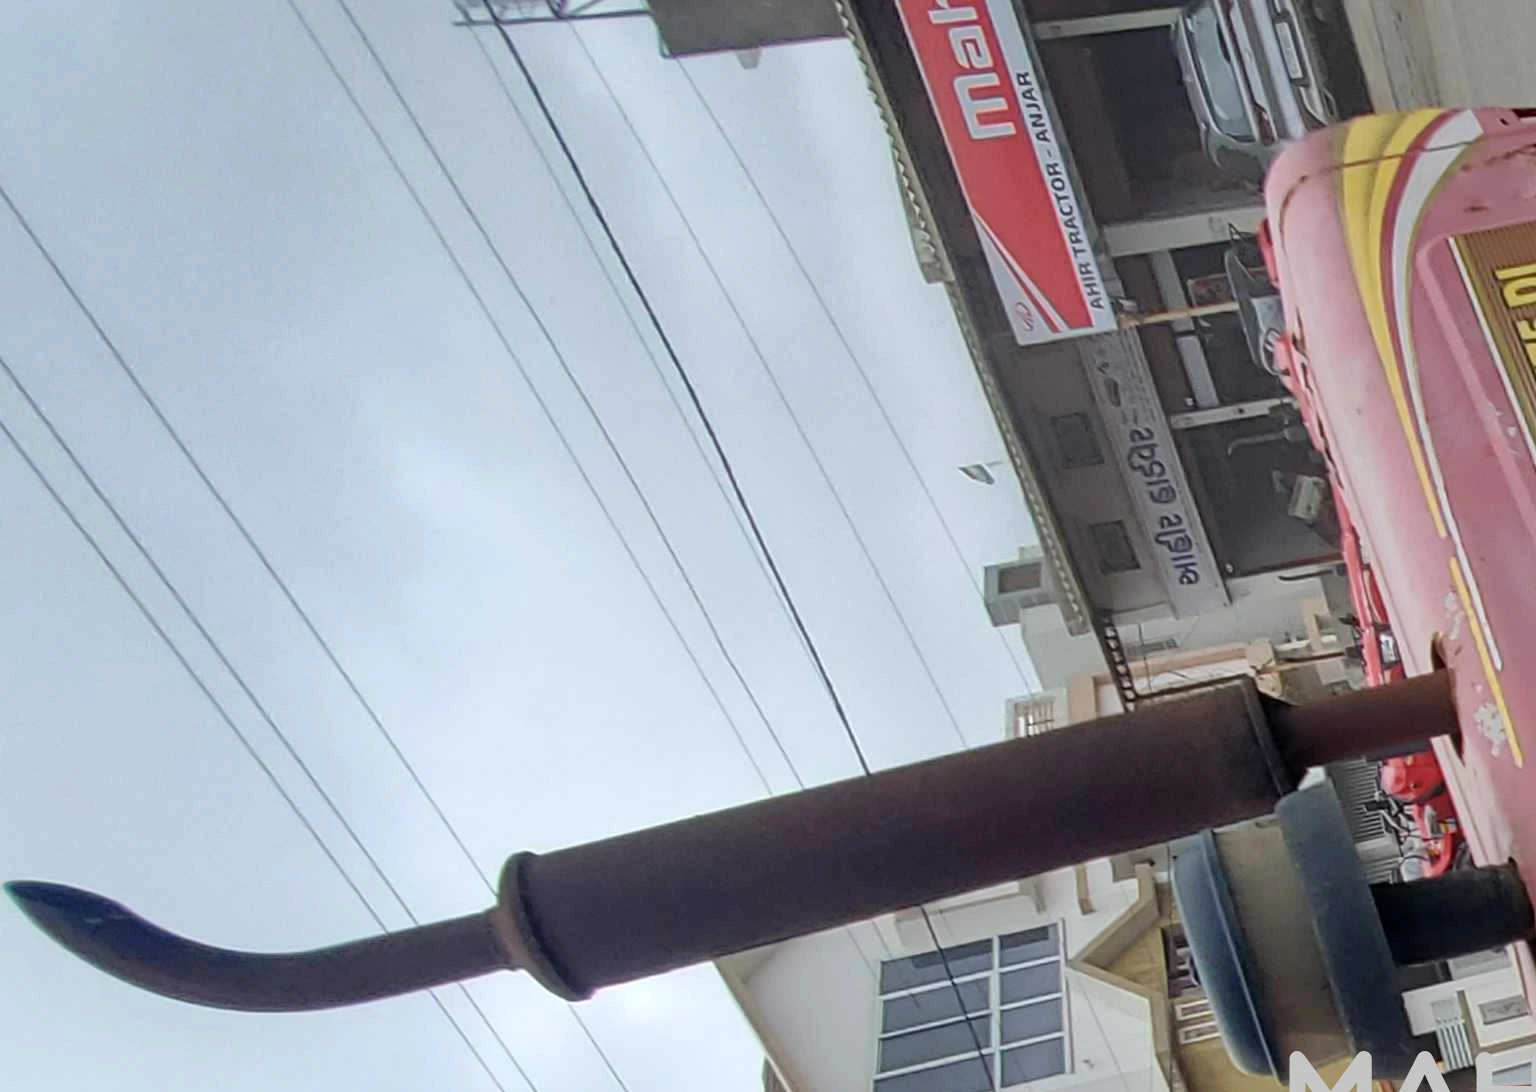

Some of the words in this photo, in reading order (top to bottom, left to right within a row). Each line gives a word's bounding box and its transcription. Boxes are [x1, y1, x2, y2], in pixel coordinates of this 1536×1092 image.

[1015, 71, 1052, 143] ANJAR
[1045, 163, 1089, 256] TRACTOR
[1079, 259, 1105, 310] AHIR
